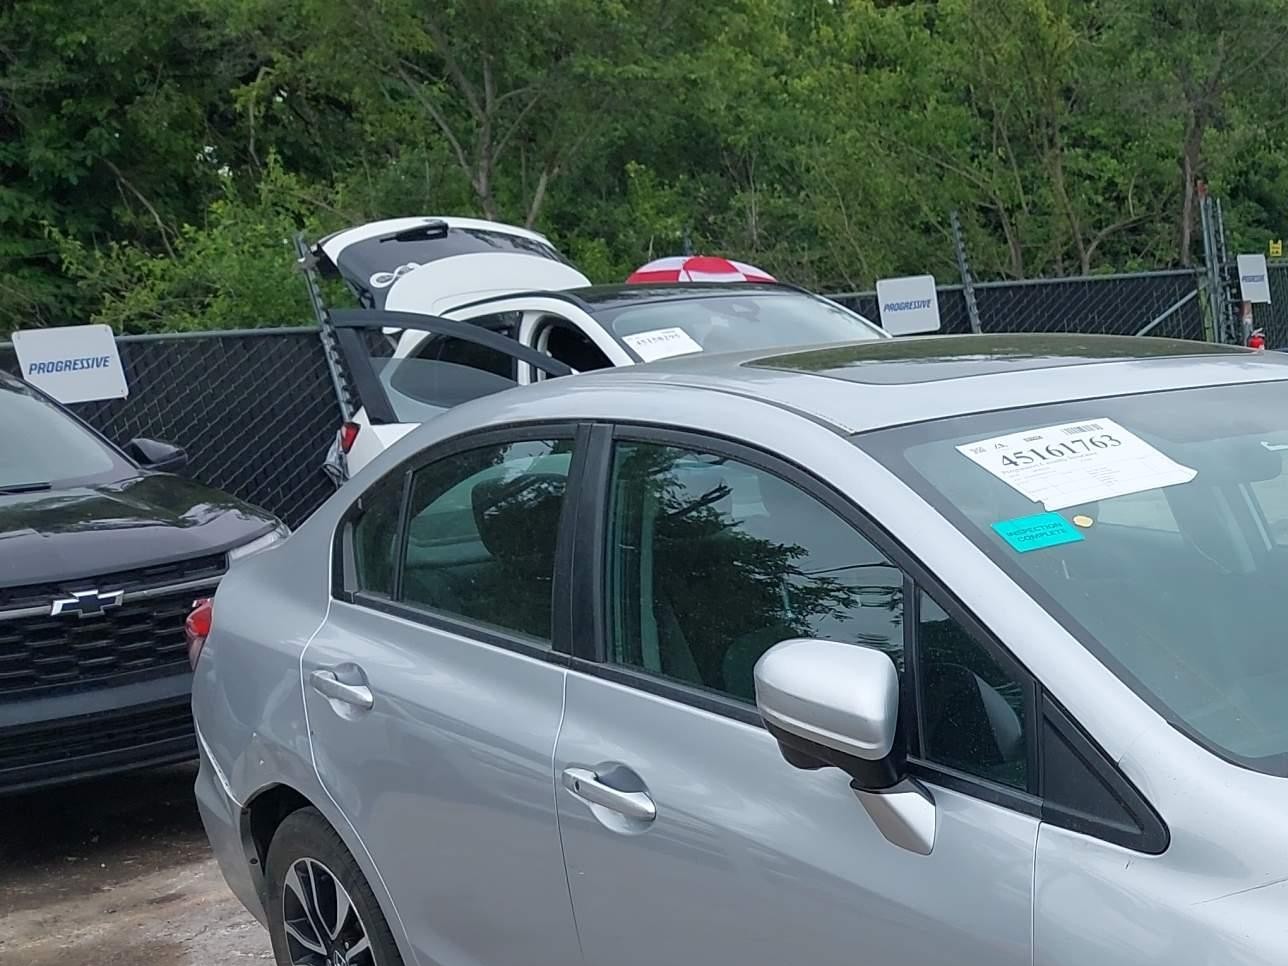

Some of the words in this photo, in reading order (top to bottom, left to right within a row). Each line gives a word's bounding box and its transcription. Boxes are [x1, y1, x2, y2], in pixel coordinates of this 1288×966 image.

[883, 299, 931, 313] PROGRESSIVE
[28, 356, 111, 375] PROGRESSIVE
[1001, 434, 1122, 467] 45161763
[1006, 522, 1063, 537] INSPECTION
[1017, 528, 1067, 542] COMPLETE
